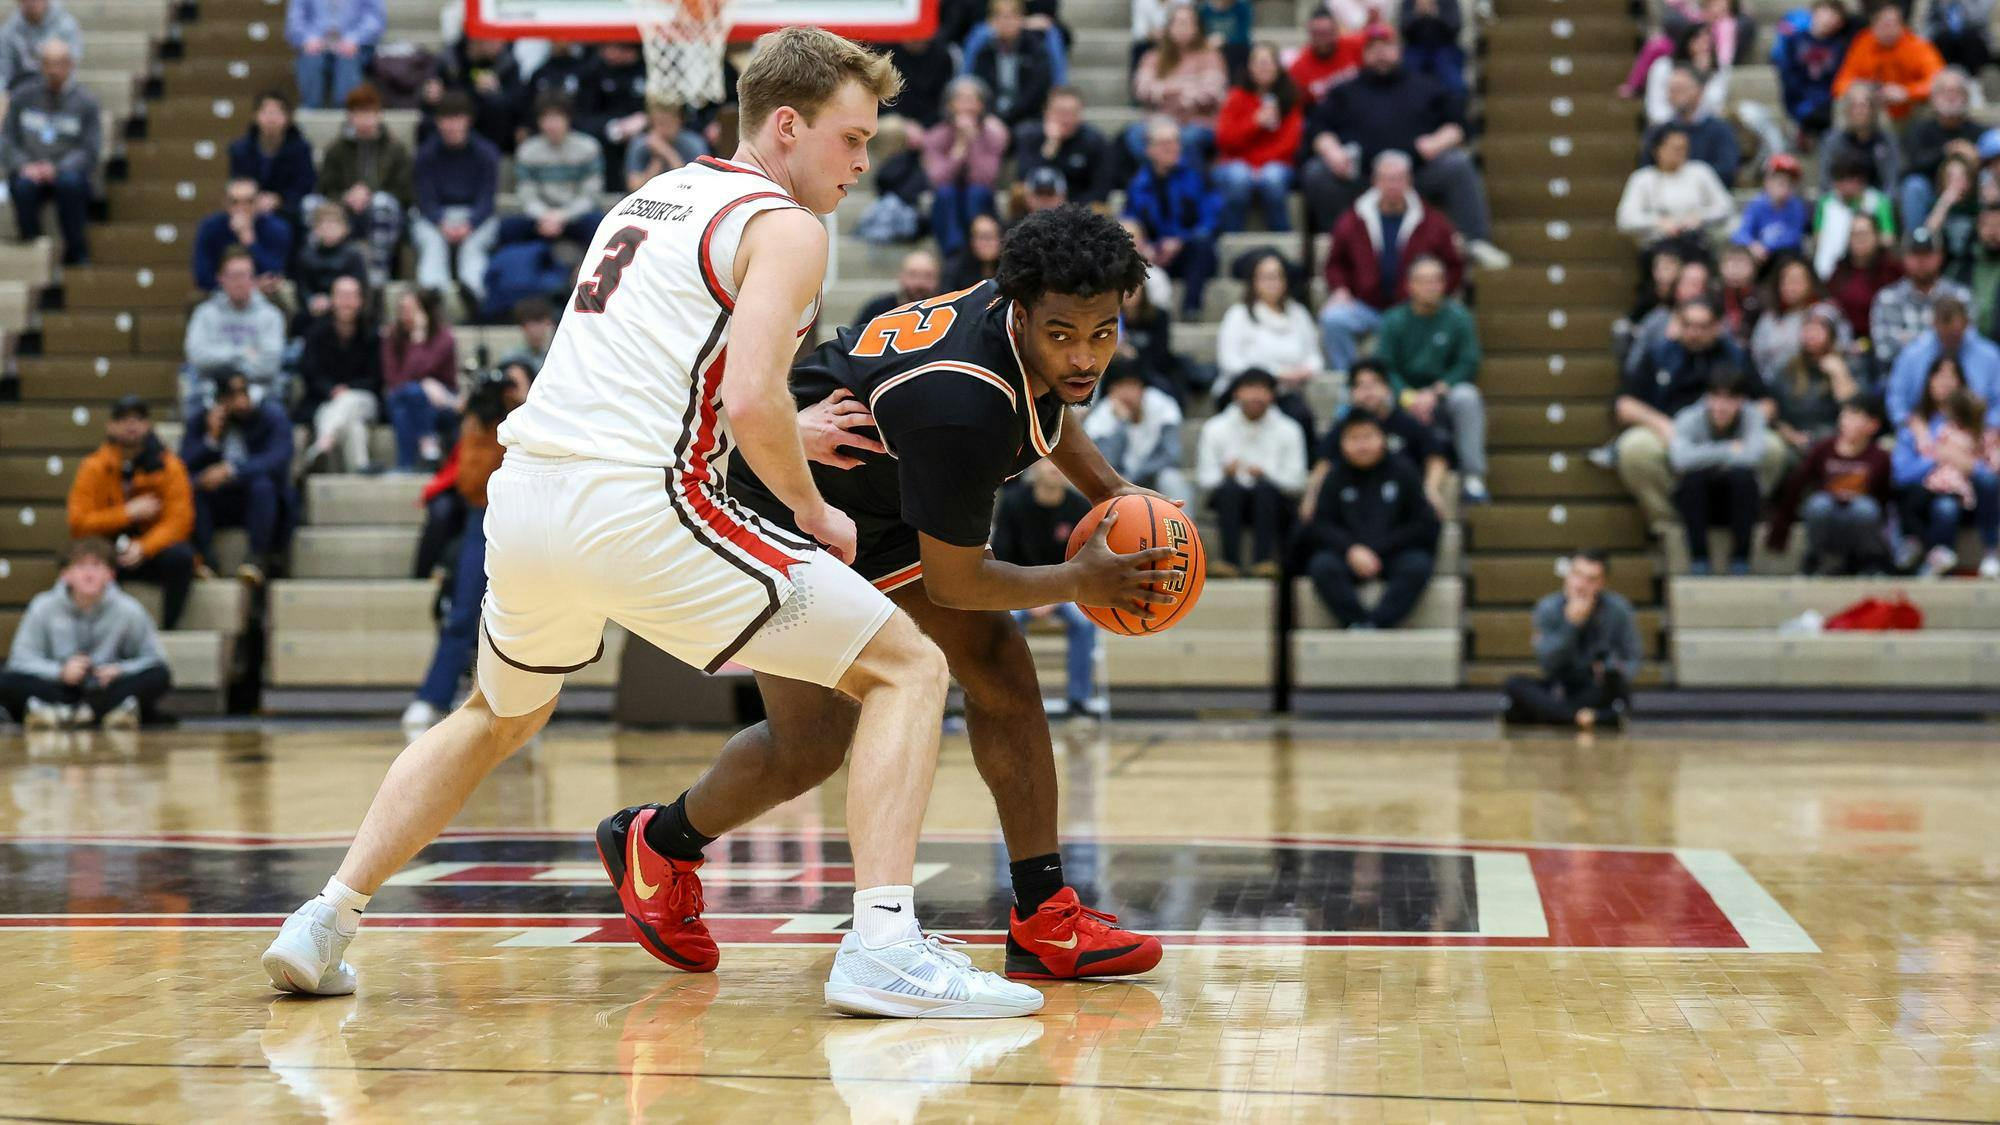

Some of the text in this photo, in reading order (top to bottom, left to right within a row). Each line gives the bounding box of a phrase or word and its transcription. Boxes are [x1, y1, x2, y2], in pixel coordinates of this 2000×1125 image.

[618, 198, 684, 221] LESBURT
[574, 225, 648, 314] 3
[1167, 518, 1189, 593] ELITE
